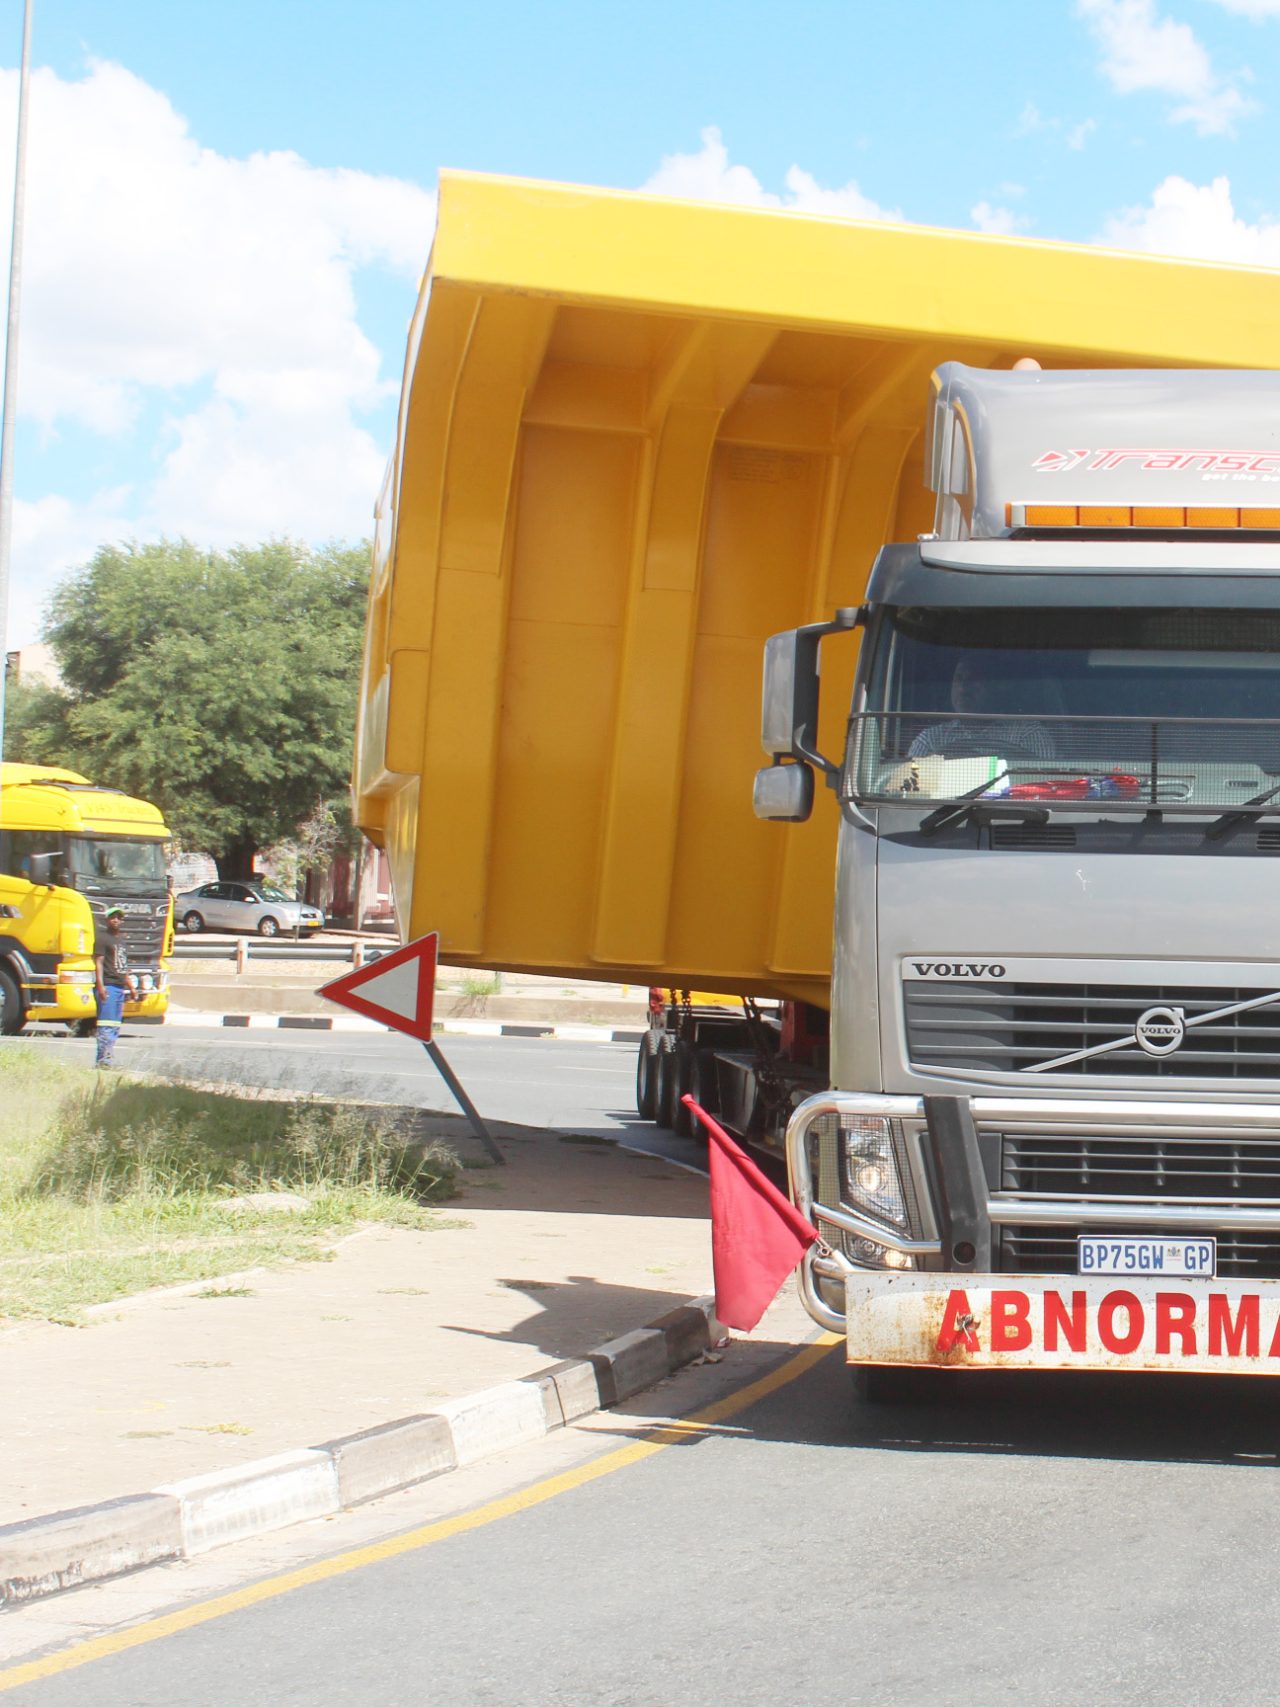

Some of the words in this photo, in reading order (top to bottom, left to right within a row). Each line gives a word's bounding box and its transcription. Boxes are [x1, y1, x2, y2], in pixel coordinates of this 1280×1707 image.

[1232, 473, 1257, 481] the
[912, 963, 1006, 978] VOLVO
[1139, 1026, 1181, 1035] VOLVO
[1083, 1245, 1164, 1269] BP75GW
[1184, 1246, 1210, 1270] GP
